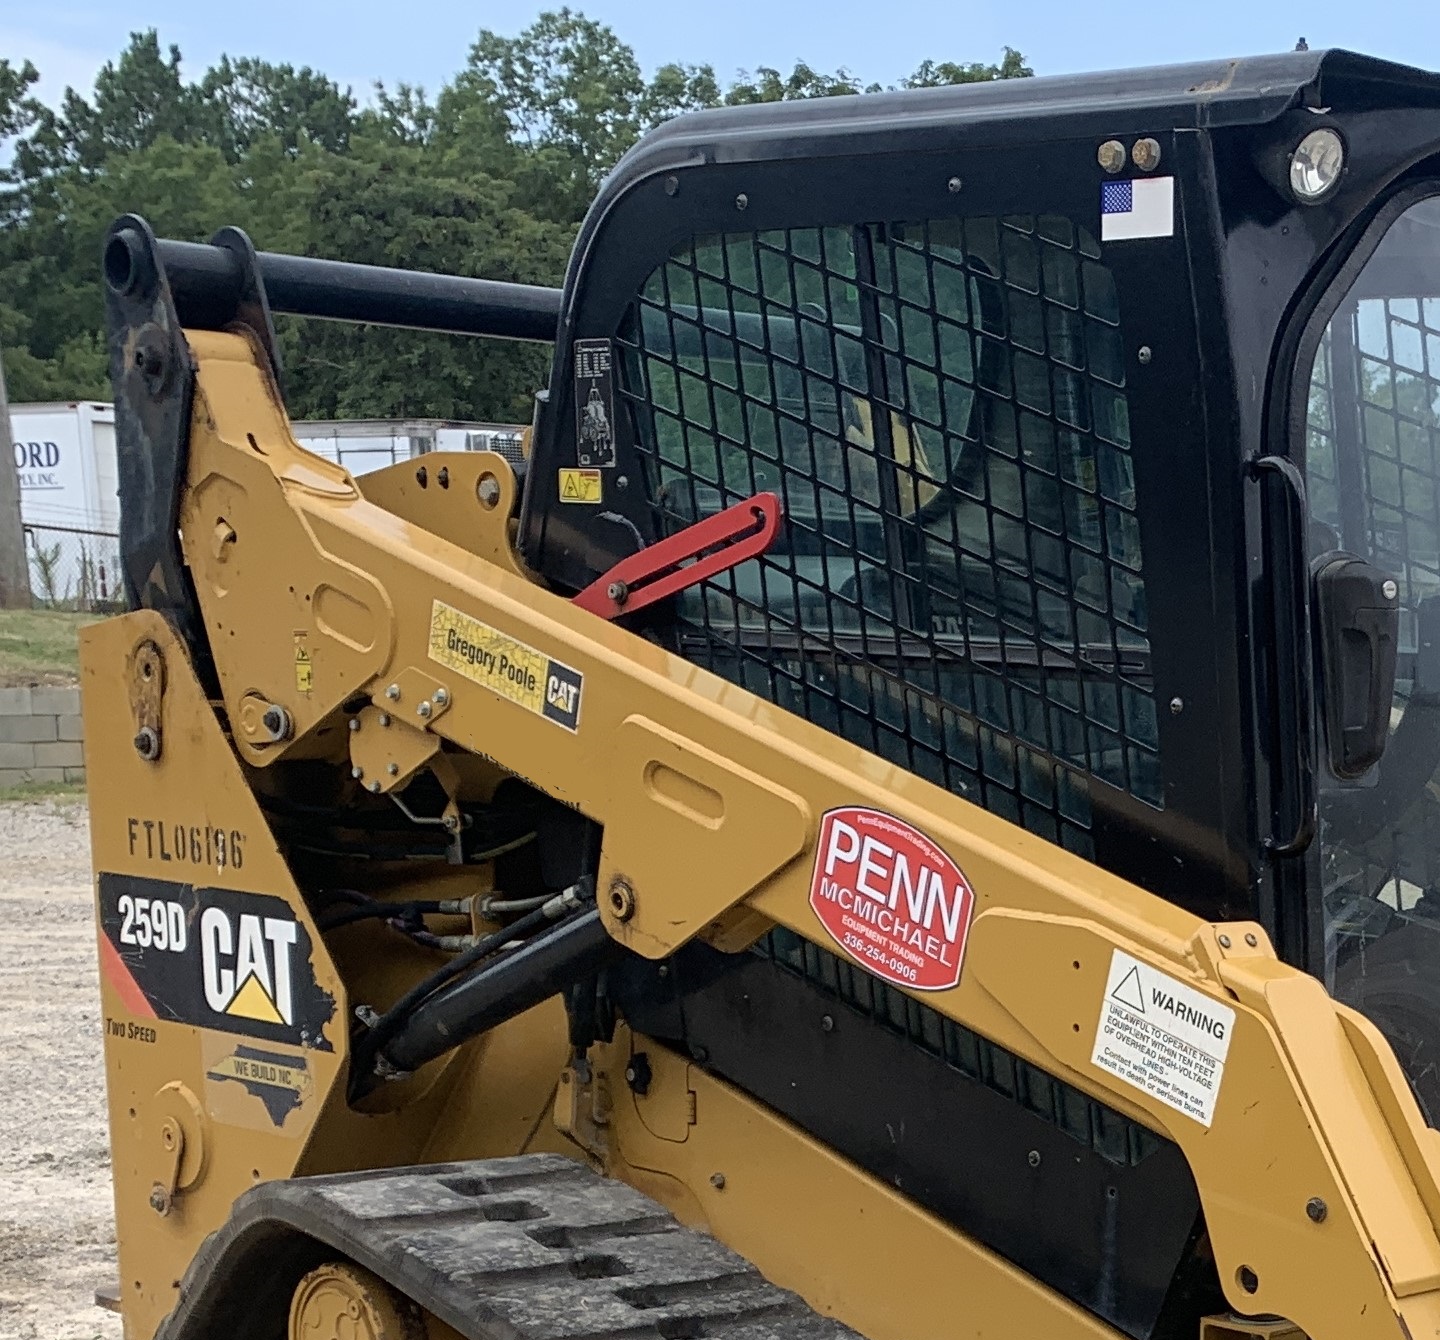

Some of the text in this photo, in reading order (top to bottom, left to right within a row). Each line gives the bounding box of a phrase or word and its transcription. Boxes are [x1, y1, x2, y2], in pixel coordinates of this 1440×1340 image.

[447, 628, 536, 692] Gregory Poole
[546, 675, 579, 714] CAT
[823, 818, 965, 945] PENN
[117, 894, 187, 953] 259D
[819, 877, 953, 968] MCMICHAEL
[841, 915, 924, 968] EQUIPMENT TRADING
[200, 906, 297, 1026] CAT
[843, 931, 918, 982] 336-254-0906
[1109, 1004, 1216, 1068] UNLAWFUL TO OPERATE THIS
[1152, 987, 1225, 1040] WARNING
[234, 1060, 292, 1085] WE BUILD NC
[1104, 1024, 1213, 1090] OF OVERHEAD HIGH-VOLTAGE
[1104, 1047, 1204, 1108] Contact with power lines can
[1107, 1015, 1215, 1078] EQUIPMENT WITHIN TEN FEET
[1142, 1056, 1164, 1075] LINES
[1096, 1055, 1206, 1120] result in death or serious burns.
